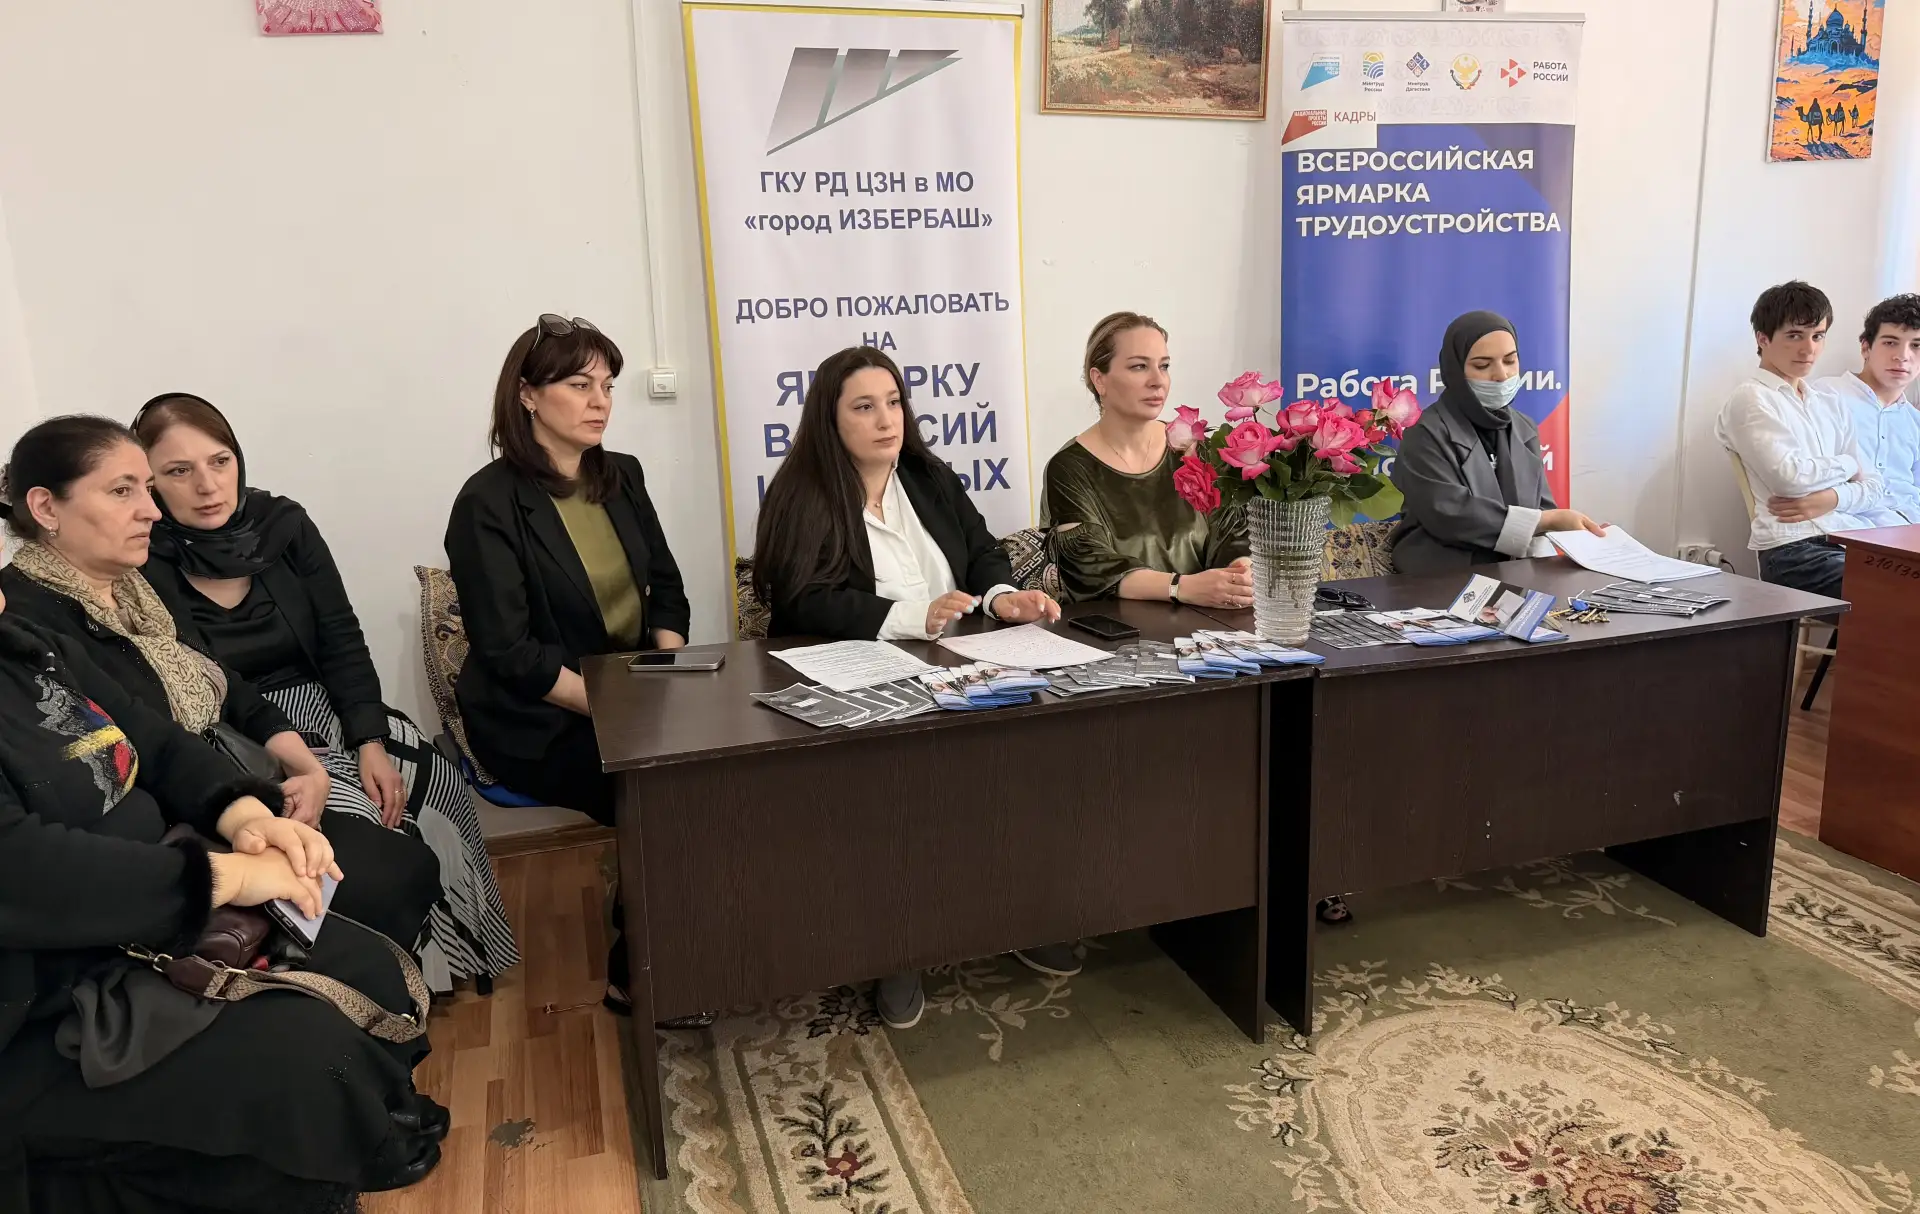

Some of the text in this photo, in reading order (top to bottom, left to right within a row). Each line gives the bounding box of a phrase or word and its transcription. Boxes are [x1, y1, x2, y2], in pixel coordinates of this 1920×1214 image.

[1533, 61, 1567, 70] РАБОТА
[1533, 72, 1568, 81] РОССИИ
[1334, 111, 1376, 124] КАДРЫ
[1298, 145, 1534, 173] ВСЕРОССИЙСКАЯ
[760, 171, 974, 197] ГКУ РД ЦЗН в МО
[1296, 182, 1431, 206] ЯРМАРКА
[744, 207, 993, 235] «город ИЗБЕРБАШ»
[1295, 208, 1561, 239] ТРУДОУСТРОЙСТВА
[735, 291, 1010, 324] ДОБРО ПОЖАЛОВАТЬ
[862, 331, 897, 351] НА
[776, 363, 981, 407] ЯРКУ
[1429, 368, 1562, 394] Рии.
[763, 402, 998, 458] ВСИЙ
